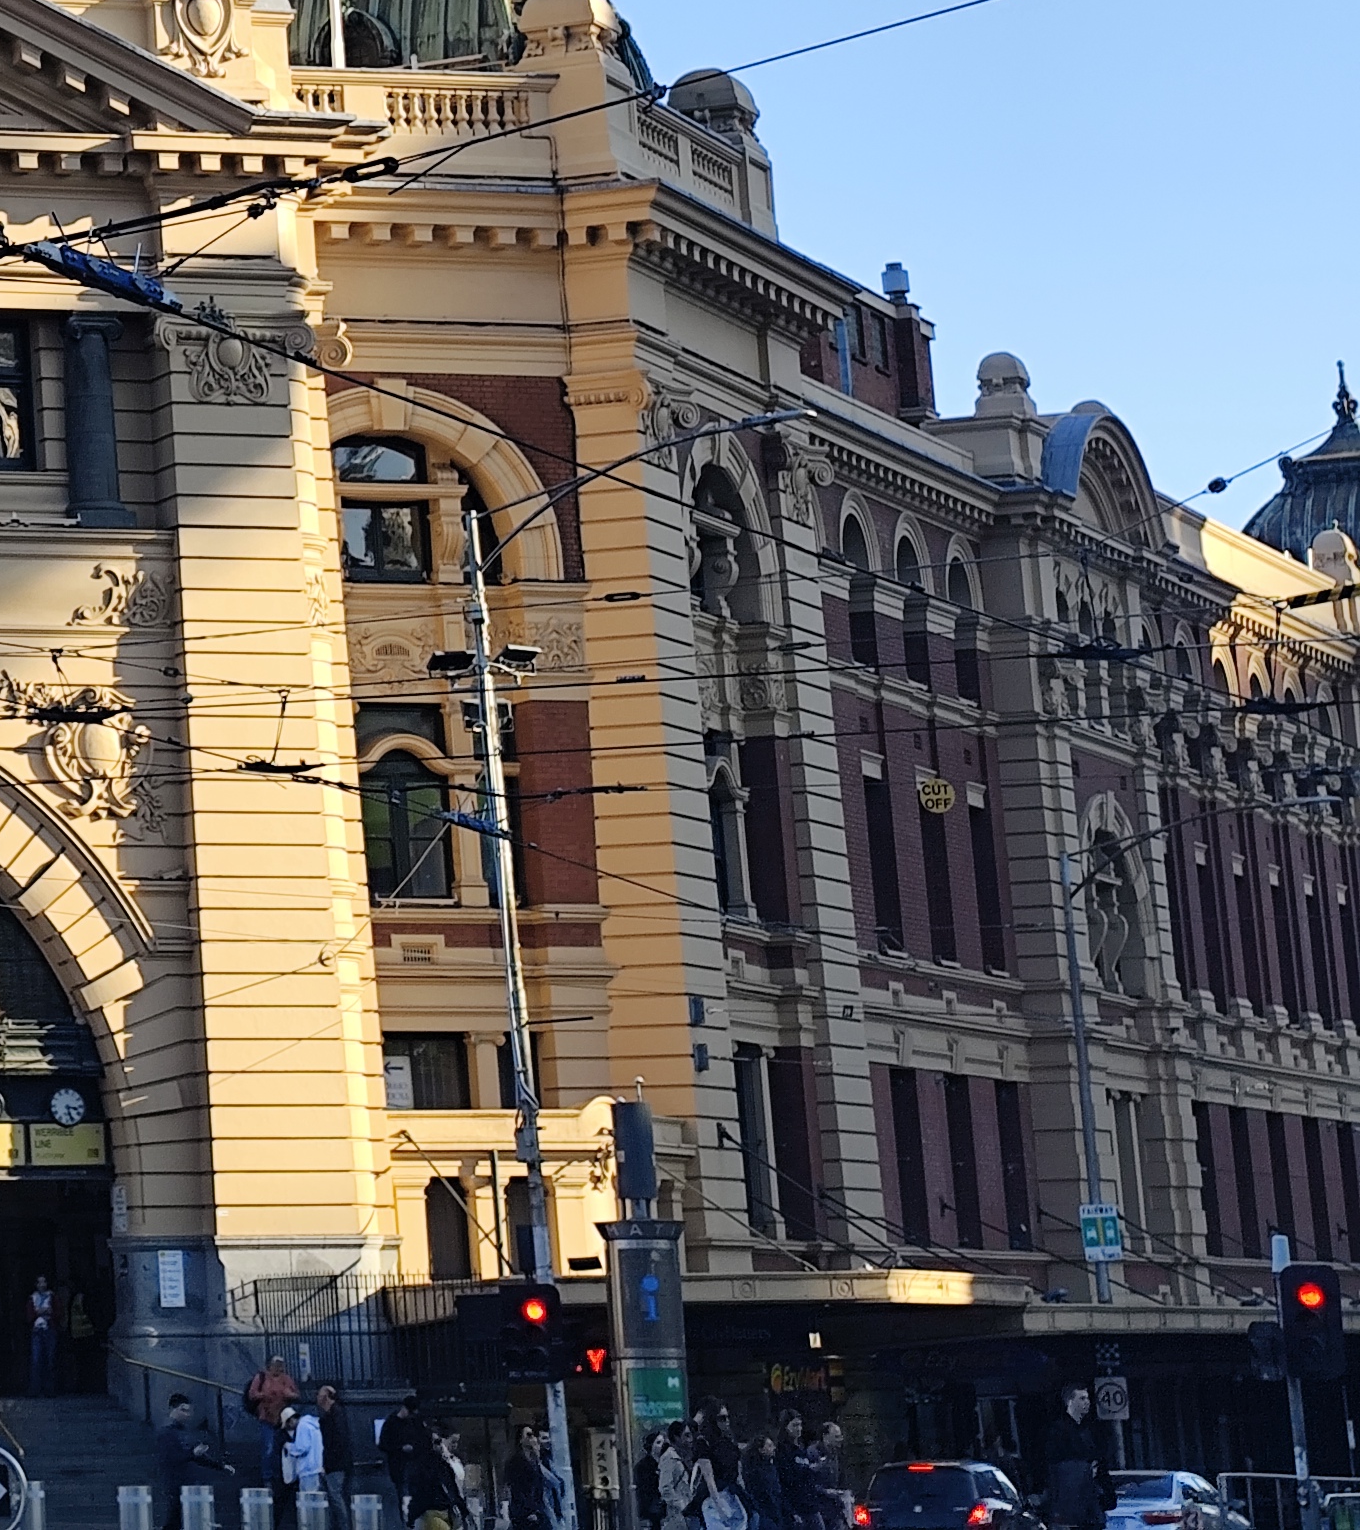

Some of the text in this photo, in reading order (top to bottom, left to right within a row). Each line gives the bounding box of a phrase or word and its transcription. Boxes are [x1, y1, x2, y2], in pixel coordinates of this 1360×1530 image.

[922, 784, 949, 796] CUT
[925, 798, 951, 809] OFF
[34, 1127, 75, 1137] WERRIBEE
[34, 1139, 52, 1149] LINE
[1101, 1390, 1124, 1408] 40
